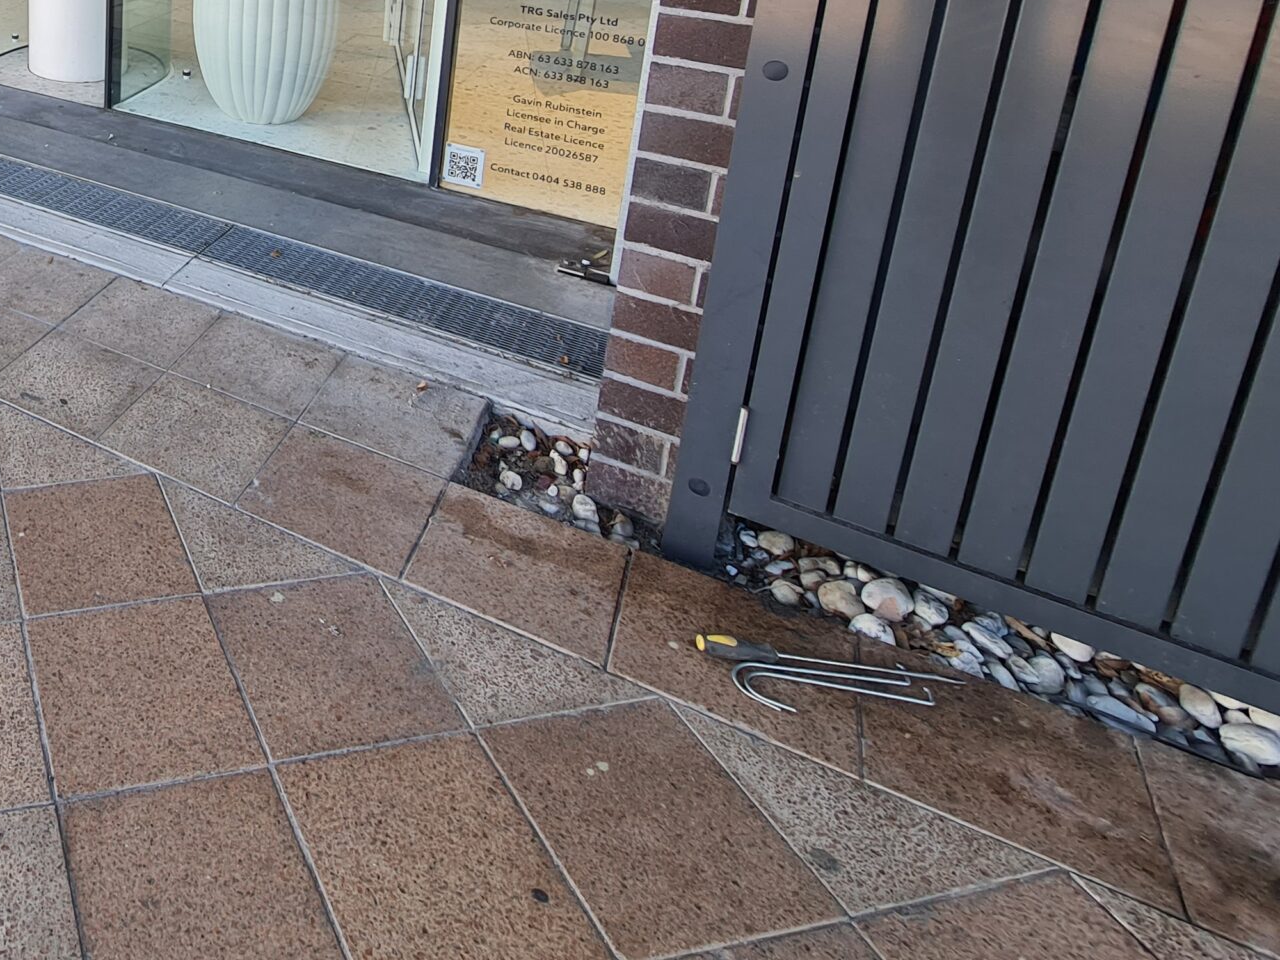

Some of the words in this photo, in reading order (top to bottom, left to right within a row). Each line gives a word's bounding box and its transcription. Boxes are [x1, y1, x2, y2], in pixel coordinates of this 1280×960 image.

[520, 5, 543, 16] TRG
[546, 9, 576, 21] Sales
[578, 13, 597, 26] Pty
[600, 16, 619, 27] Ltd
[489, 16, 542, 32] Corporate
[544, 24, 586, 39] Licence
[589, 31, 610, 42] 100
[612, 34, 635, 46] 868
[508, 49, 535, 61] ABN:
[537, 54, 551, 64] 63
[553, 56, 573, 68] 633
[576, 60, 597, 72] 878
[600, 63, 620, 75] 163
[513, 65, 541, 78] ACN:
[543, 70, 564, 81] 633
[565, 73, 587, 85] 878
[590, 78, 610, 89] 163
[512, 94, 543, 108] Gavin
[544, 100, 603, 119] Rubinstein
[506, 107, 552, 125] Licensee
[554, 117, 564, 127] in
[566, 119, 606, 136] Charge
[504, 122, 527, 134] Real
[528, 127, 561, 141] Estate
[563, 134, 605, 151] Licence
[504, 137, 544, 153] Licence
[544, 145, 599, 164] 20026587
[490, 162, 531, 179] Contact
[532, 172, 560, 185] 0404
[563, 178, 583, 190] 538
[585, 183, 607, 196] 888
